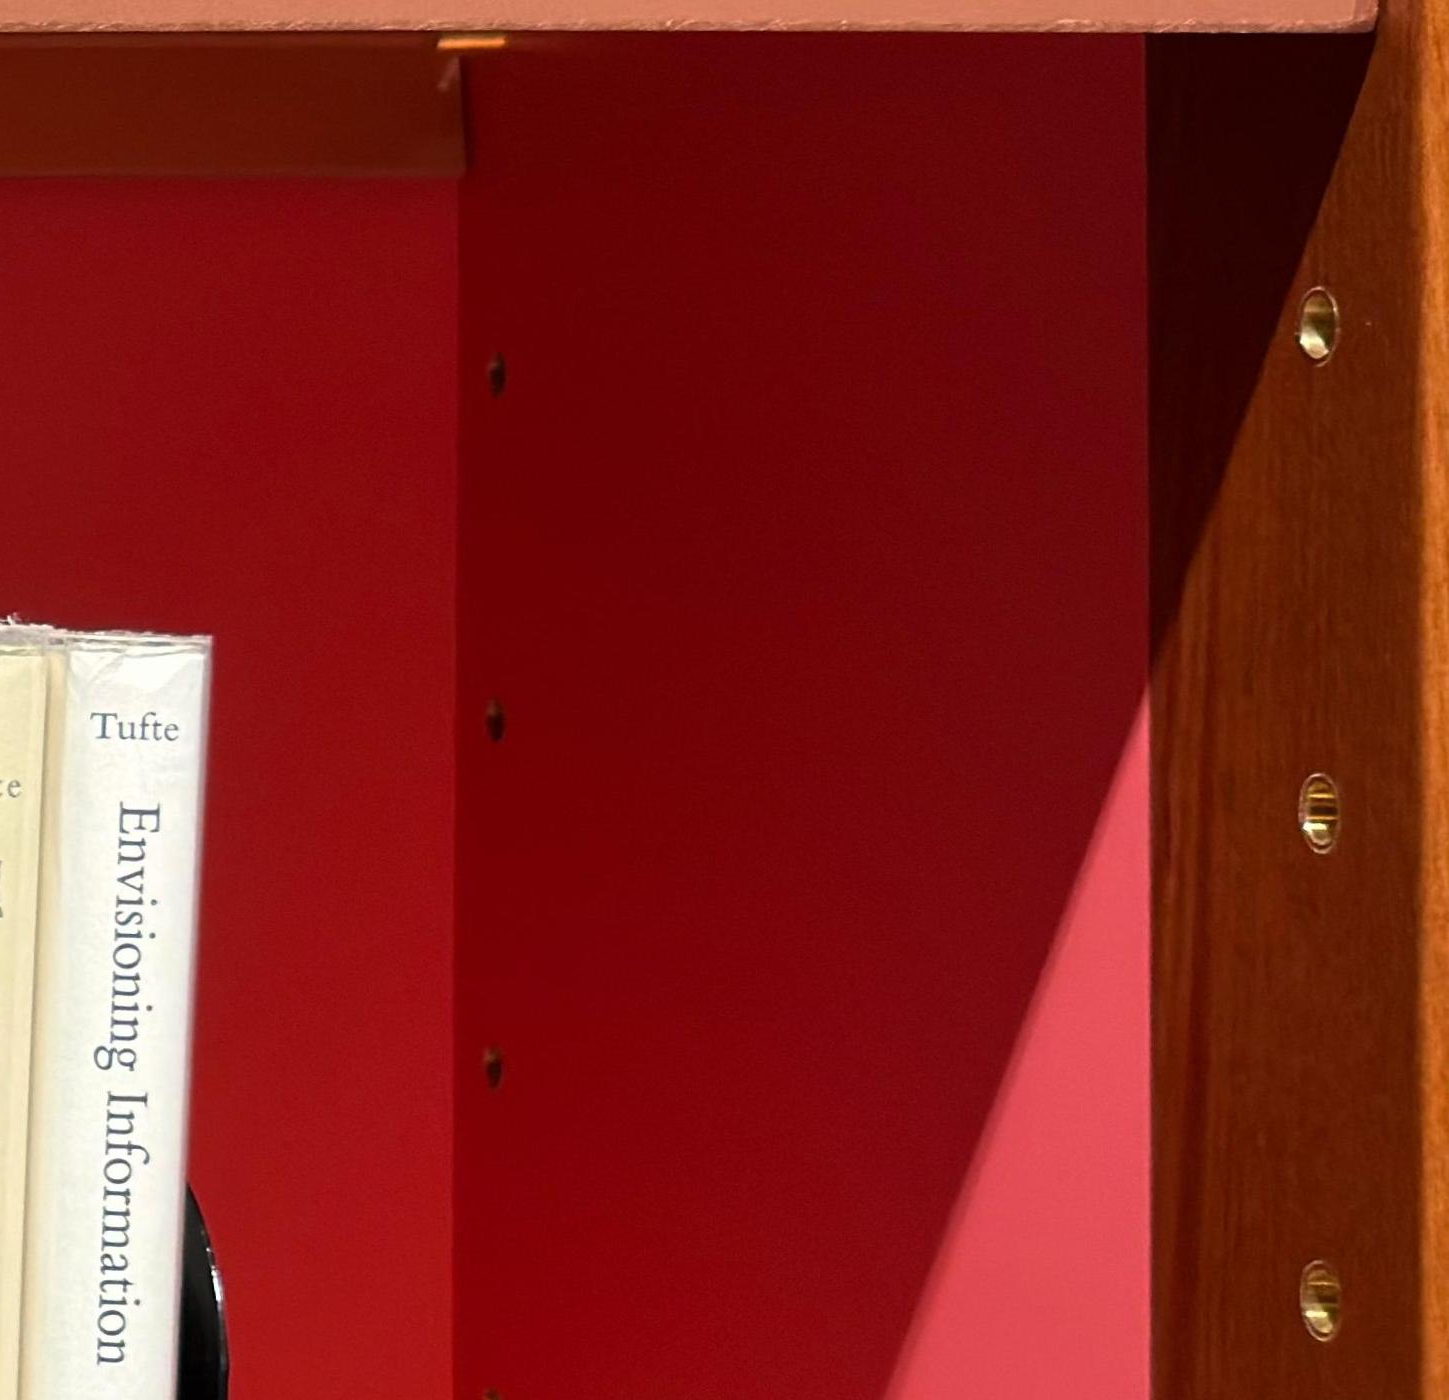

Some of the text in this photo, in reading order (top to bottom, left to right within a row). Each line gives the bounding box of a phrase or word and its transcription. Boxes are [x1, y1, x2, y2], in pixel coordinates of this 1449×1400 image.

[90, 711, 180, 741] Tufte
[95, 802, 160, 1364] Envisioning Information
